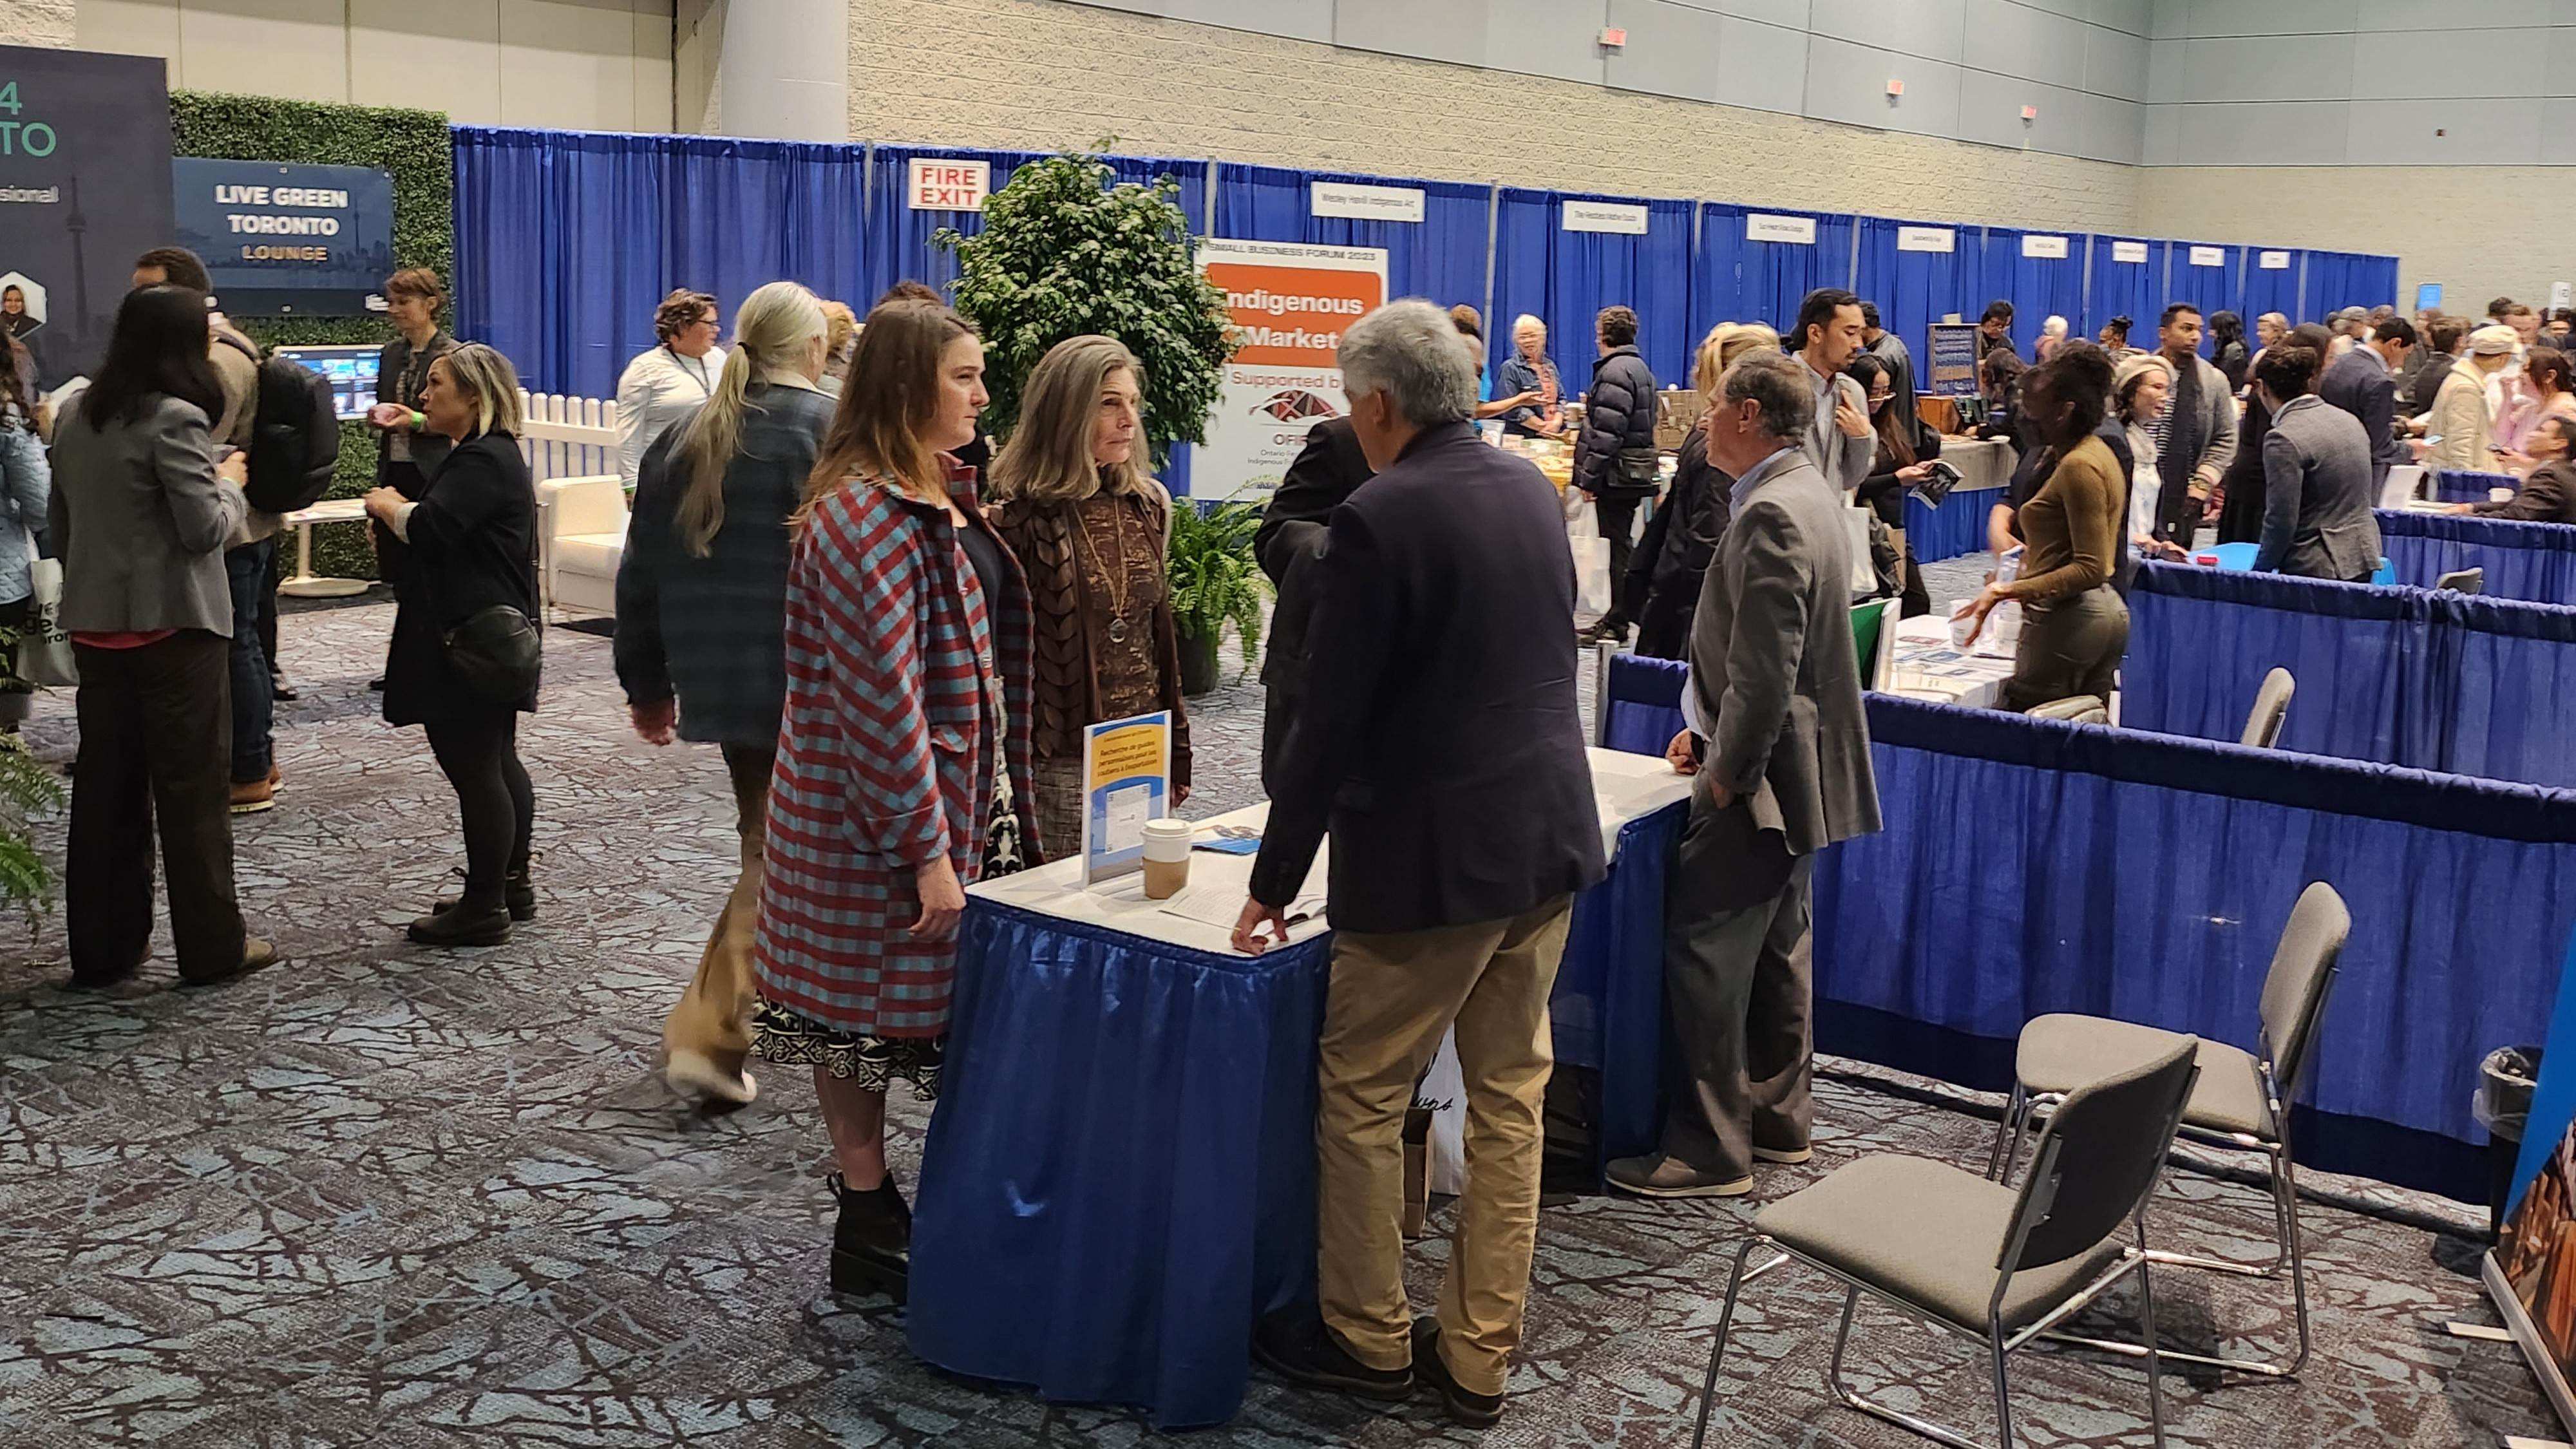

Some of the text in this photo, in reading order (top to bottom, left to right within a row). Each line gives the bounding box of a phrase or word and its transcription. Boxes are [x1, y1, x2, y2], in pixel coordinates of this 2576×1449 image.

[921, 167, 976, 185] FIRE
[215, 184, 348, 208] LIVE GREEN
[921, 187, 977, 205] EXIT
[227, 214, 340, 236] TORONTO
[242, 245, 328, 261] LOUNGE
[1209, 243, 1377, 260] SMALL BUSINESS FORUM 2023
[1244, 326, 1340, 349] Market
[1231, 371, 1340, 388] Supported b
[1247, 457, 1283, 466] Indigenous
